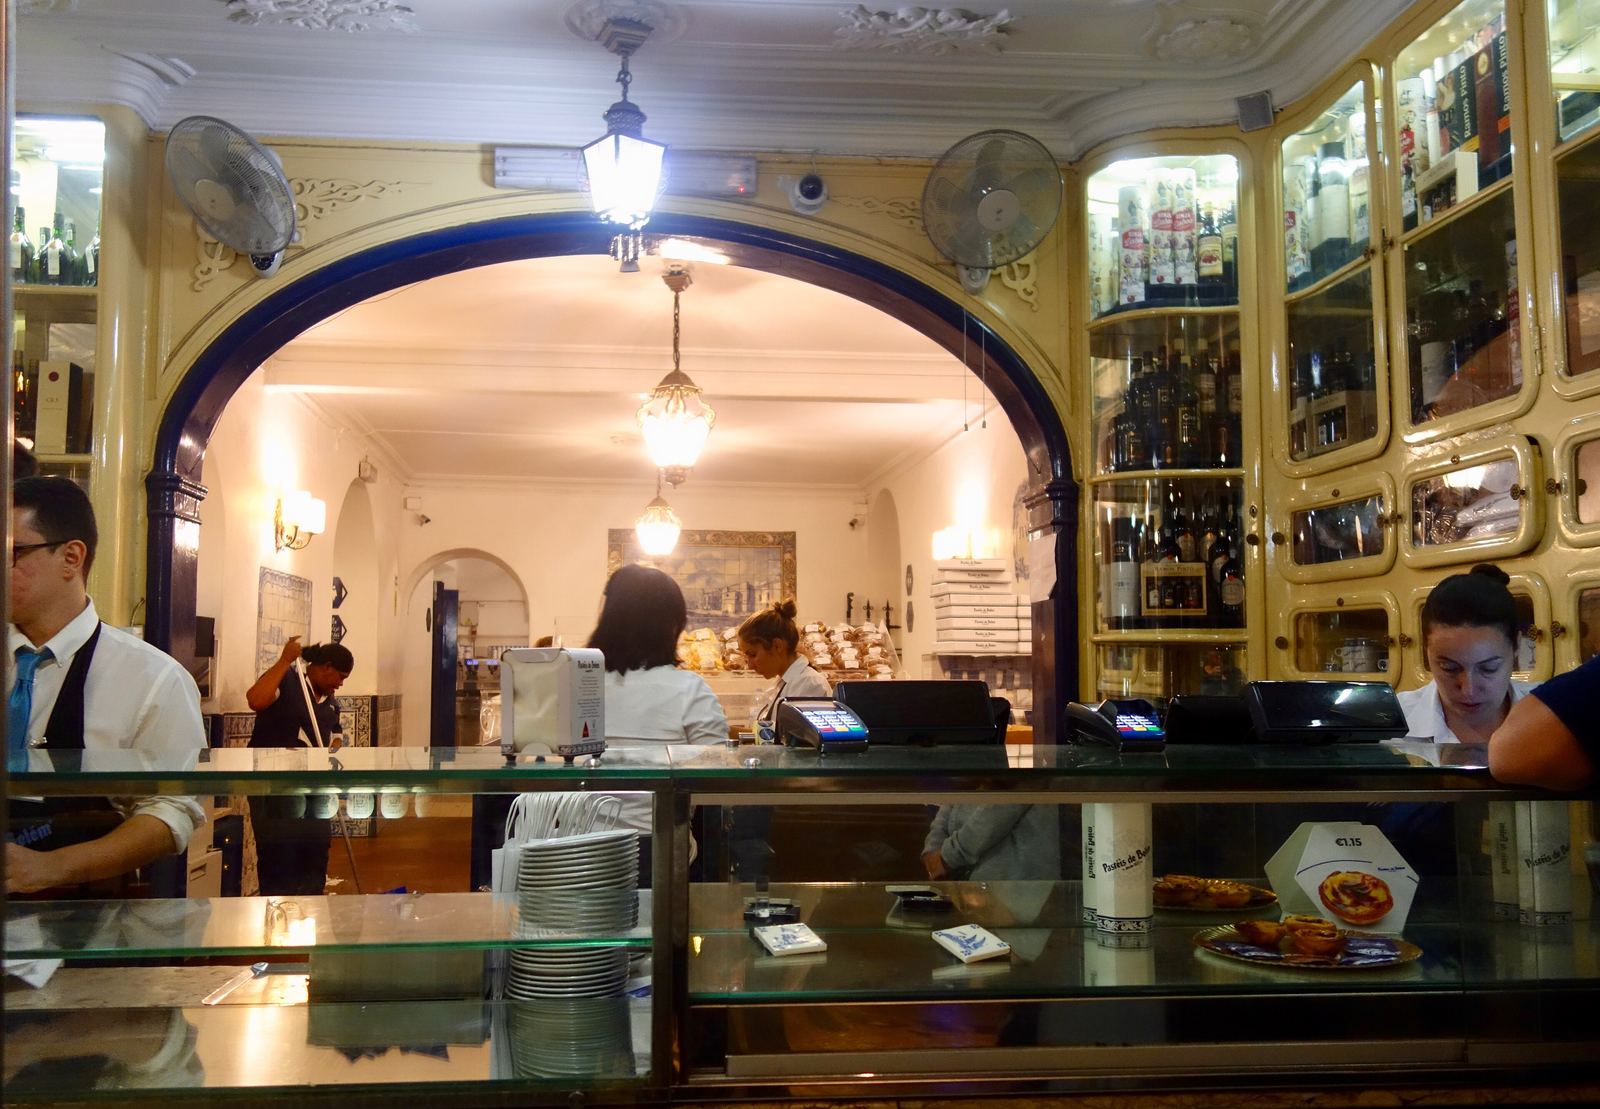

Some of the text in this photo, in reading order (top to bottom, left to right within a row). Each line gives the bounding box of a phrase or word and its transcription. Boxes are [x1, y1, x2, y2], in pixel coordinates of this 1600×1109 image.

[1498, 36, 1510, 112] Ramos Pinto
[1459, 65, 1472, 138] Ramos Pinto
[1127, 855, 1137, 864] de
[1335, 837, 1362, 847] €1.15
